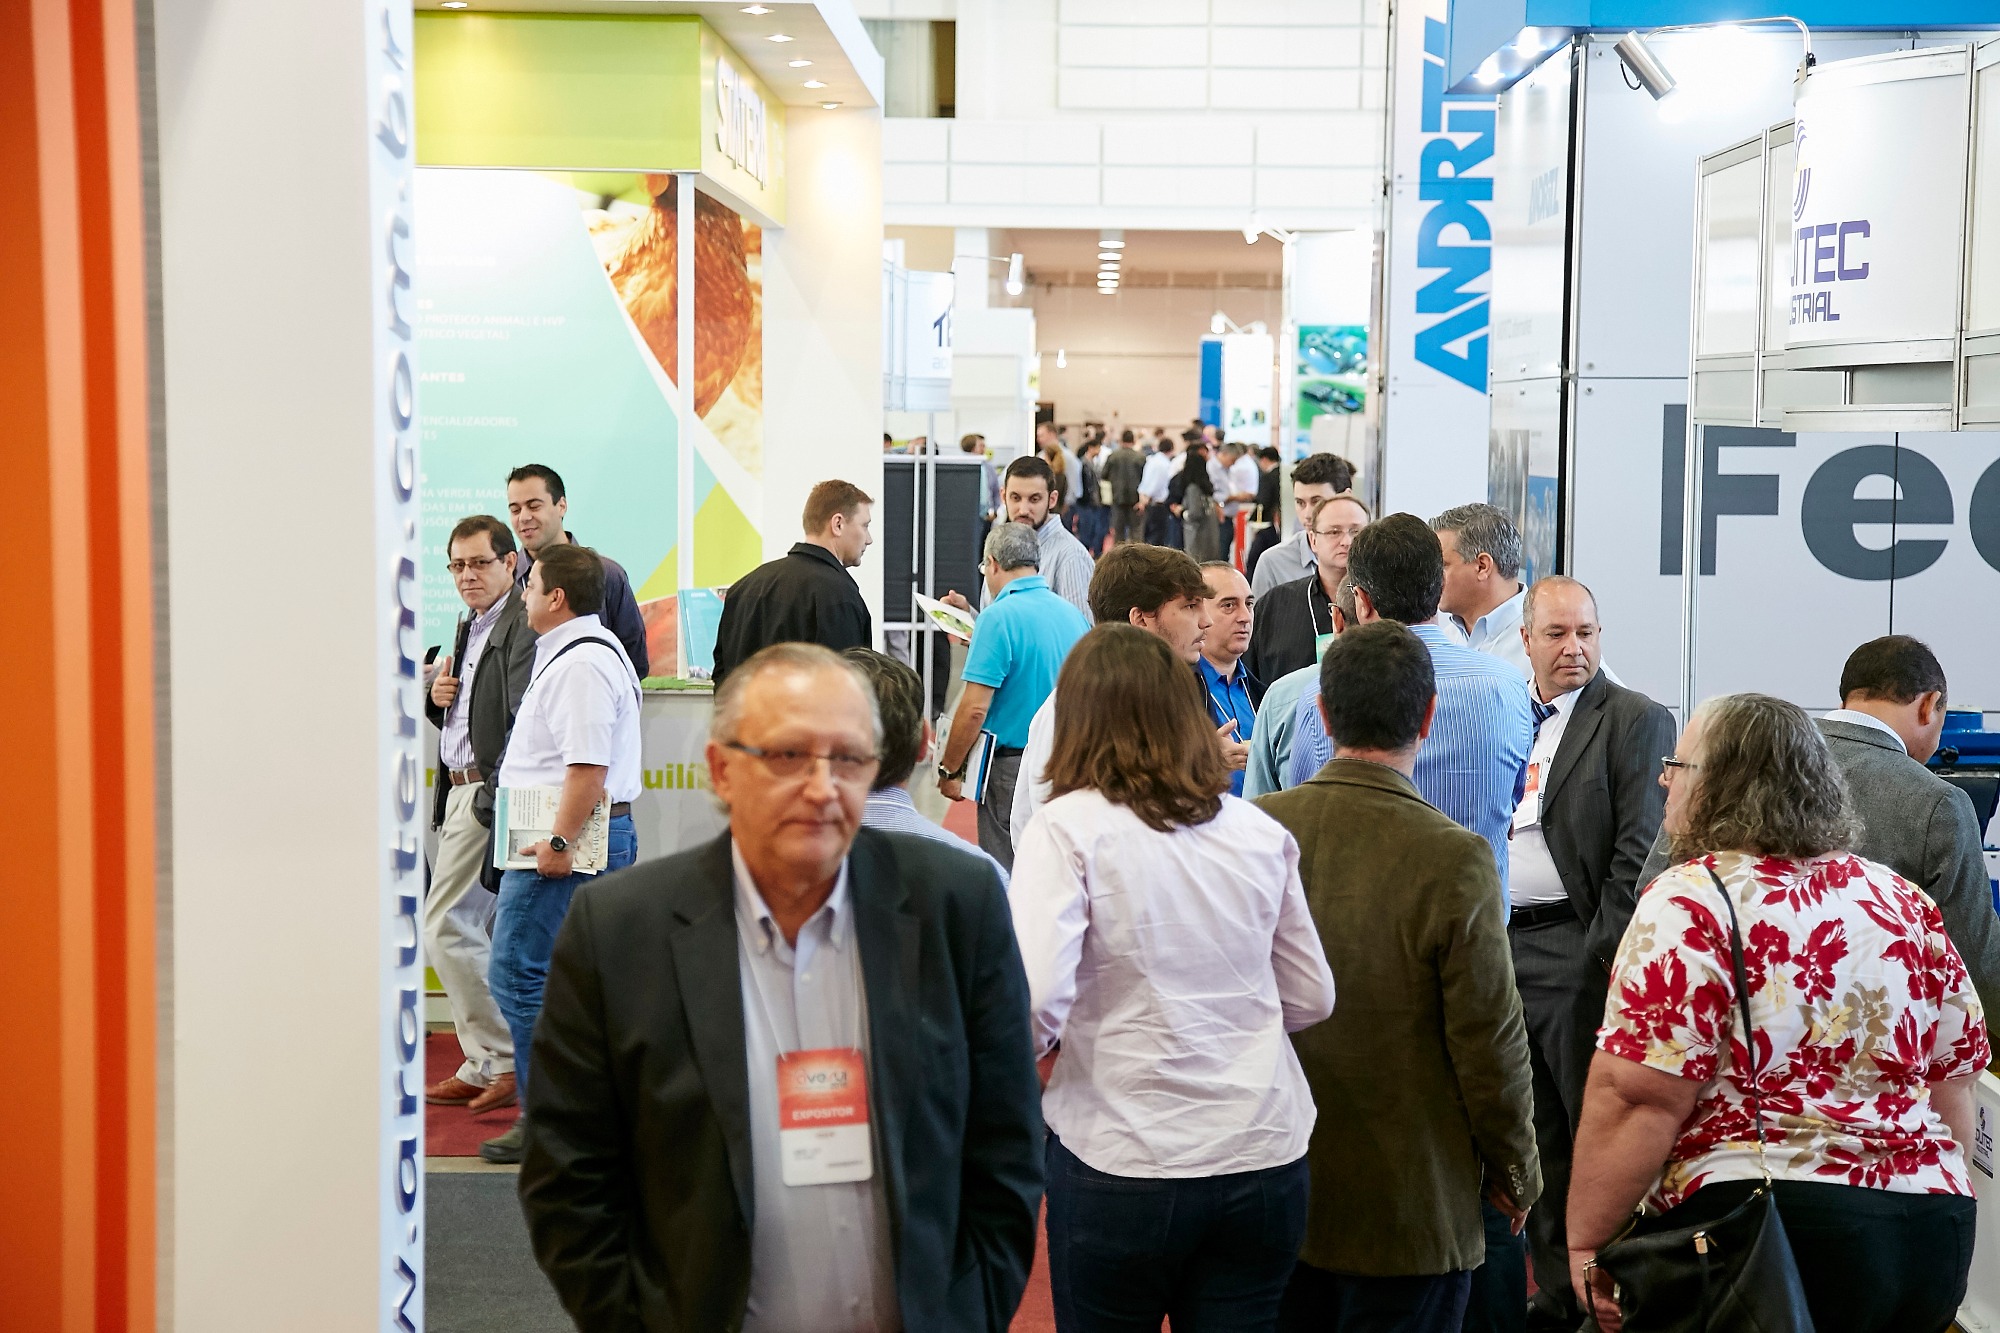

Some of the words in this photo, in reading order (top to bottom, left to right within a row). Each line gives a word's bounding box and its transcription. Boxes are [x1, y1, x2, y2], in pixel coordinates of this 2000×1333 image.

[1790, 291, 1840, 325] STRIAL
[1660, 404, 2000, 581] Fe
[792, 1107, 854, 1121] EXPOSITOR
